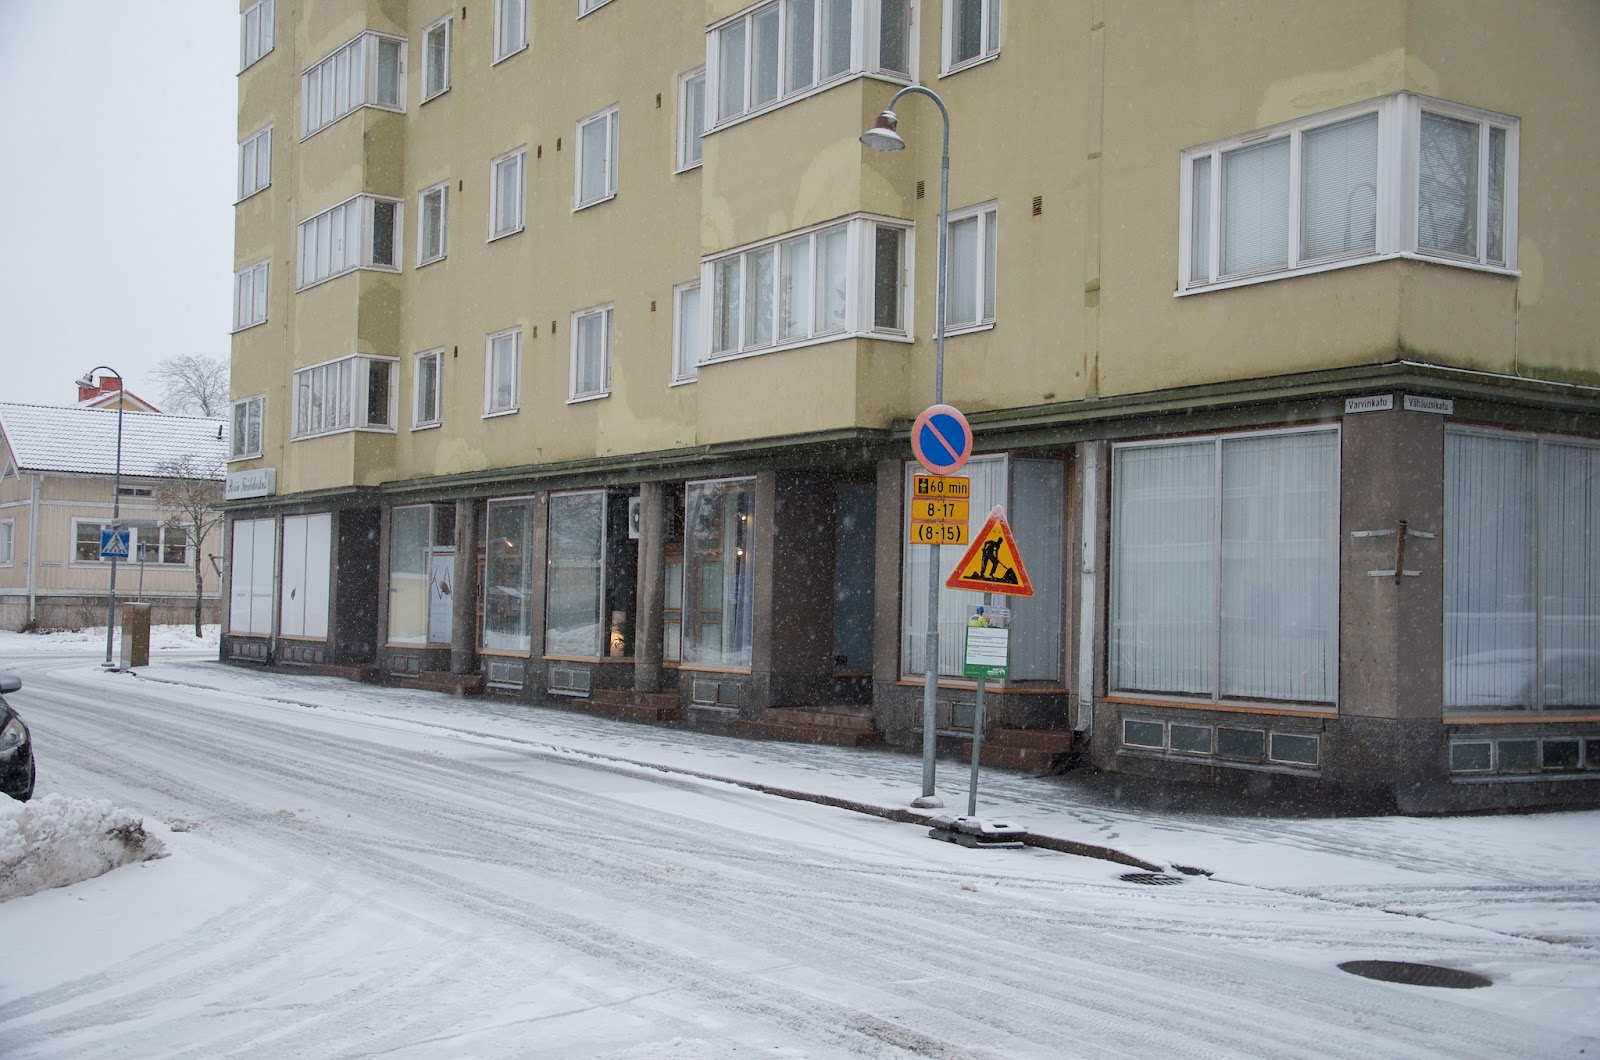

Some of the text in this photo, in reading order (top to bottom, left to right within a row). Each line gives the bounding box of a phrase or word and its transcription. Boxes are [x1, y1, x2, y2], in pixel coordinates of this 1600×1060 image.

[1348, 398, 1388, 410] Varvinkatu
[930, 480, 967, 494] 60 min
[927, 502, 955, 518] 8-17
[918, 524, 961, 543] (8-15)
